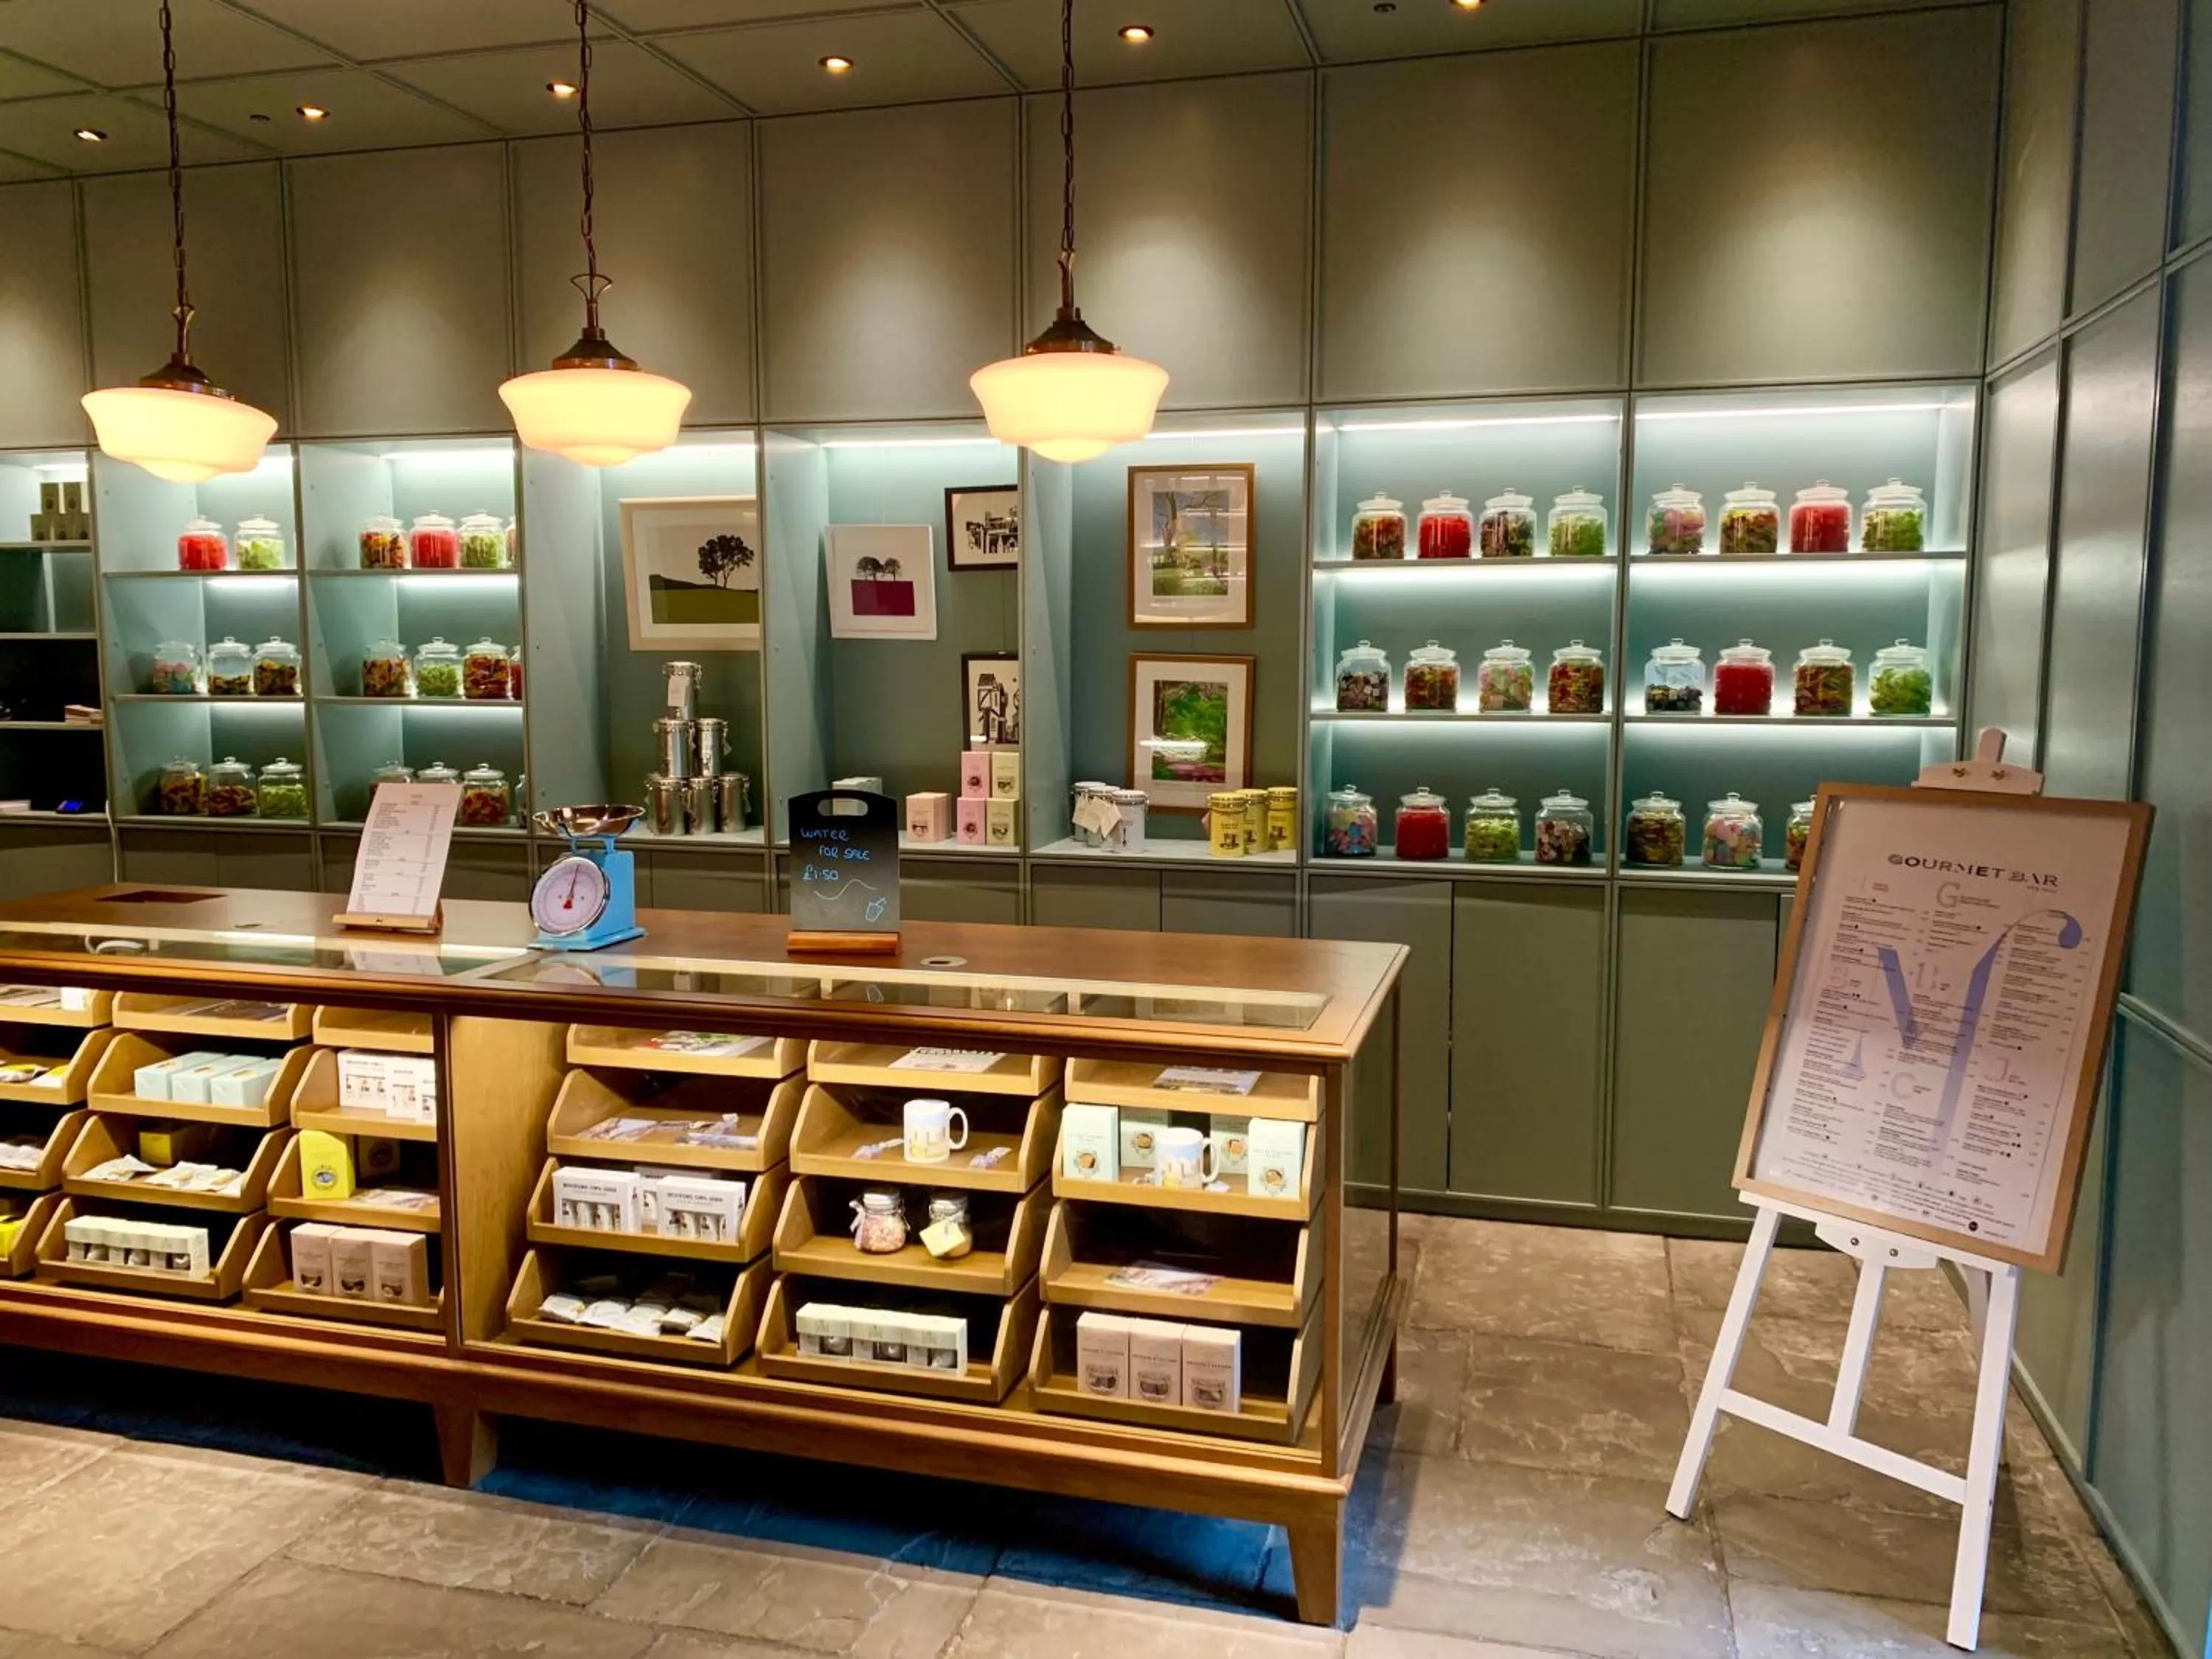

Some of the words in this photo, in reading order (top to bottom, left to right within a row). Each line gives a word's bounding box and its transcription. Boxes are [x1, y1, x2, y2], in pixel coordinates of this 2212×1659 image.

[800, 827, 849, 841] WATER
[819, 844, 838, 858] FOR
[1887, 853, 2006, 879] GOURMET
[2008, 870, 2059, 887] BAR
